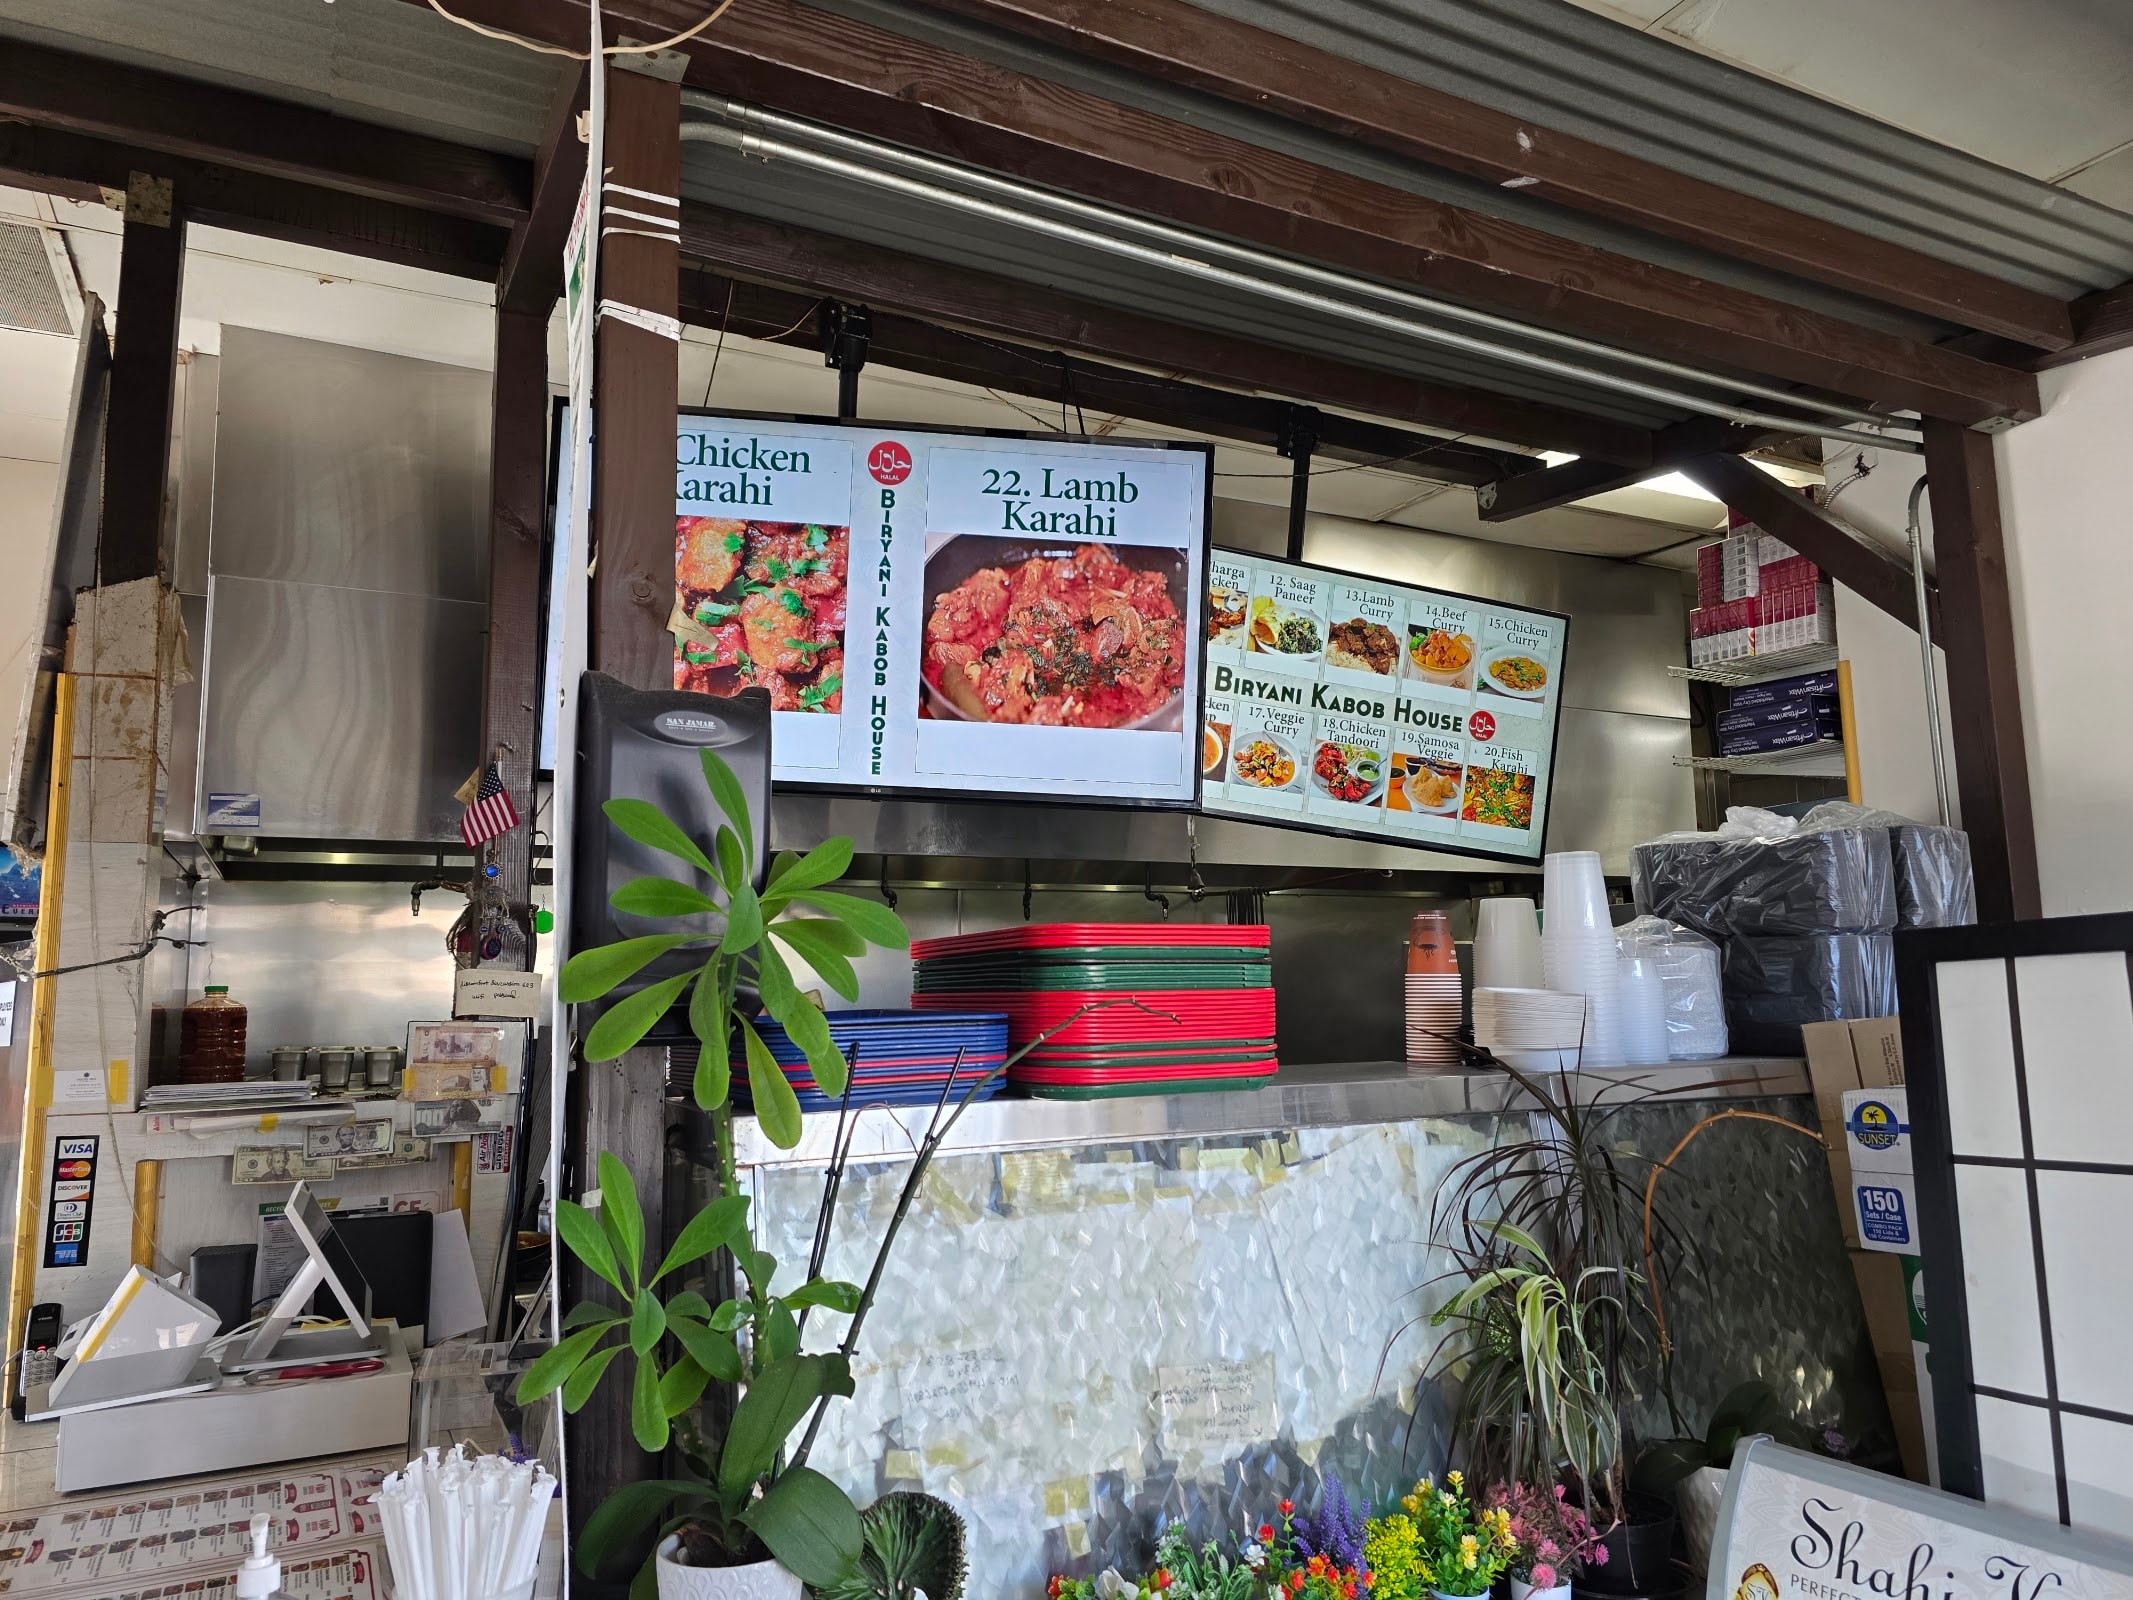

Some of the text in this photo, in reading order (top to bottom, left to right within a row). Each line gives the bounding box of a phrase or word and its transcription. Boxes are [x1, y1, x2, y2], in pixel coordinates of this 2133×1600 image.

[677, 433, 812, 474] Chicken
[880, 473, 900, 481] HALAL
[981, 468, 1139, 503] 22. Lamb
[677, 469, 773, 506] arahi
[1001, 500, 1117, 536] Karahi
[1210, 560, 1245, 580] harga
[1269, 575, 1317, 595] 12. Saag
[1275, 587, 1315, 605] Paneer
[1359, 603, 1394, 622] Curry
[871, 488, 895, 775] BIRYANI KABOB HOUSE
[1432, 617, 1466, 635] Curry
[1507, 632, 1540, 650] Curry
[1214, 665, 1463, 733] BIRYANI KABOB HOUSE
[666, 717, 684, 725] SAN
[1264, 721, 1300, 739] Curry
[1326, 729, 1379, 749] Tandoori
[1417, 744, 1454, 761] Veggie
[1492, 758, 1529, 775] Karahi
[63, 1143, 93, 1154] VISA
[1858, 1132, 1897, 1146] SUNSET
[58, 1165, 91, 1173] MasterCard
[1863, 1189, 1899, 1213] 150
[1865, 1211, 1880, 1219] Sets
[1885, 1213, 1902, 1221] Case
[1790, 1497, 1955, 1600] Shahi
[1791, 1573, 1863, 1600] PERFEC
